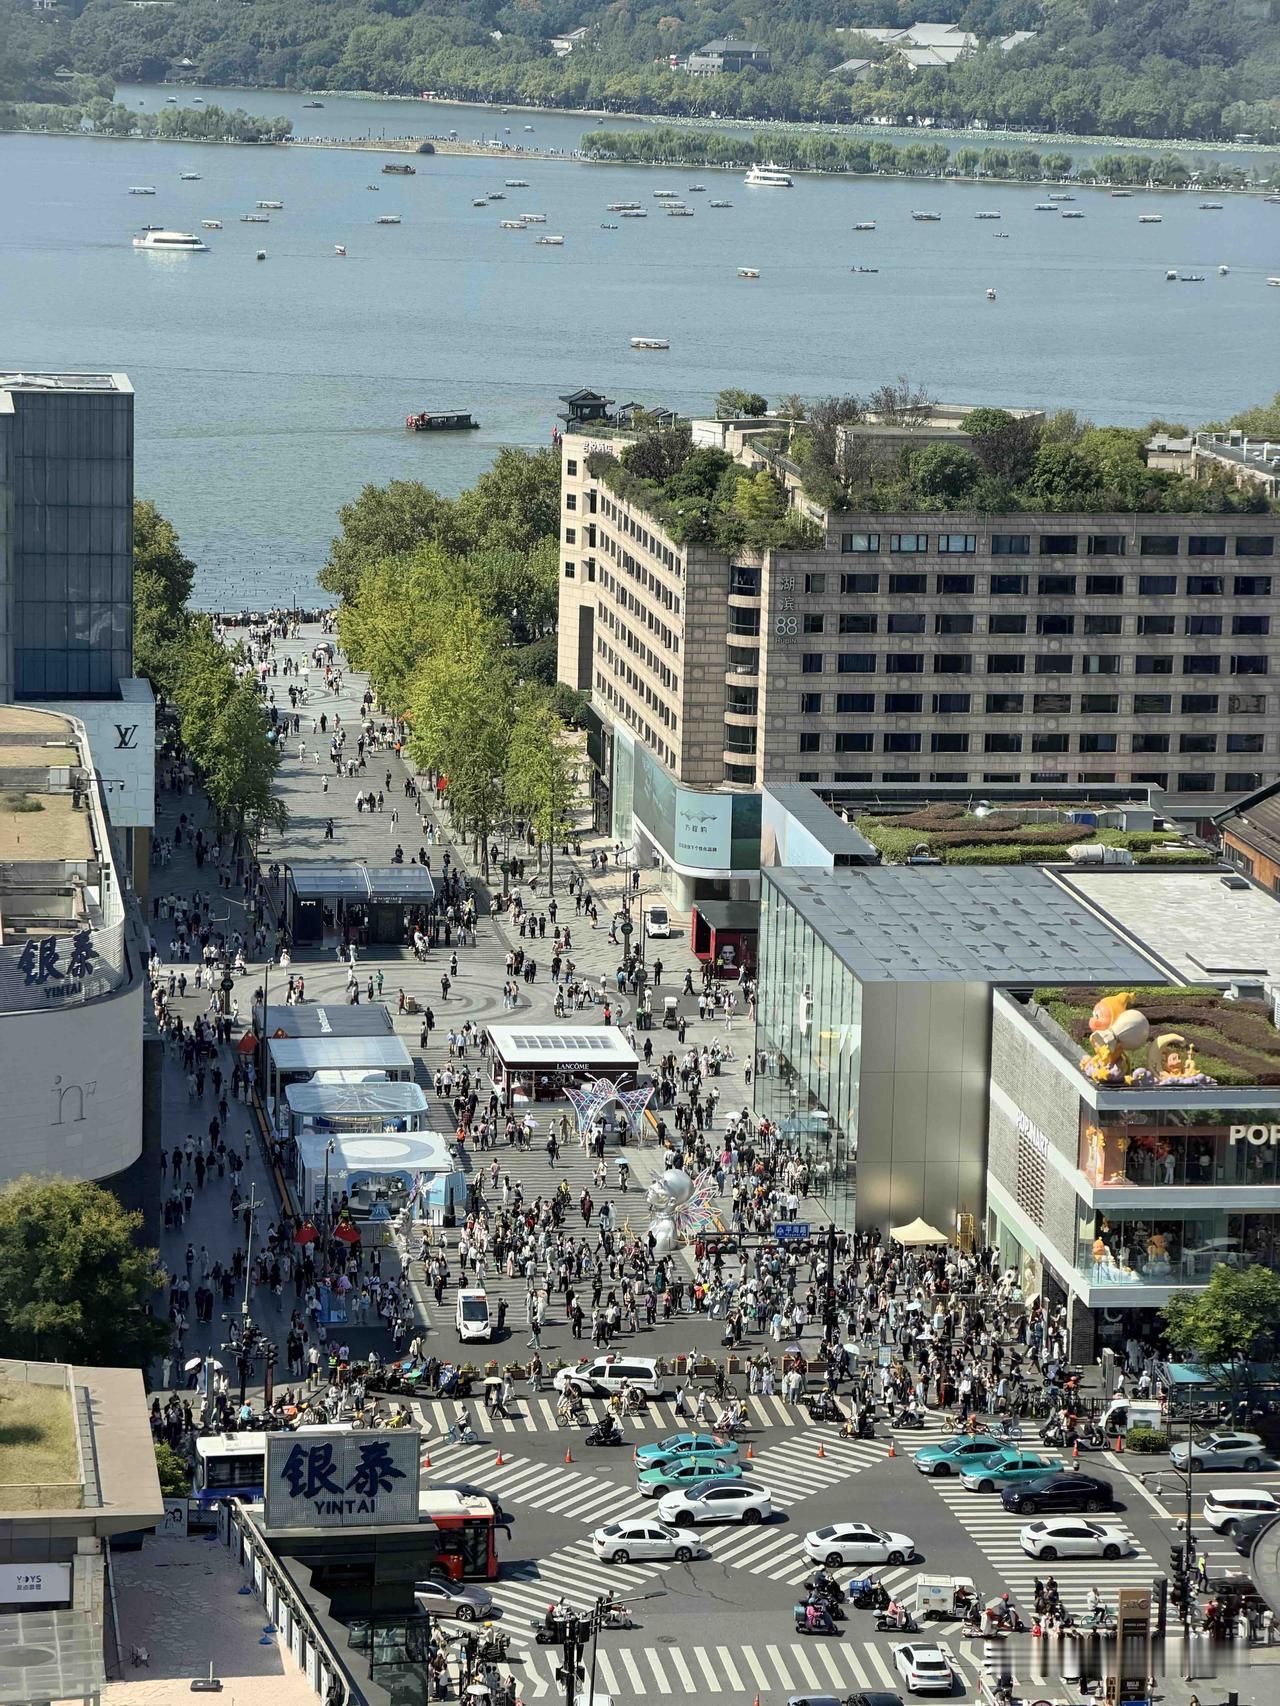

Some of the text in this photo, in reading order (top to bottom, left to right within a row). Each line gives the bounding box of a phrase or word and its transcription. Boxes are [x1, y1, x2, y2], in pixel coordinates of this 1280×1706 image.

[113, 724, 139, 749] LV
[17, 928, 100, 986] 银泰
[44, 981, 82, 998] YINTAI
[1229, 1125, 1280, 1146] POP
[281, 1441, 407, 1499] 银泰
[314, 1500, 375, 1515] YINTAI
